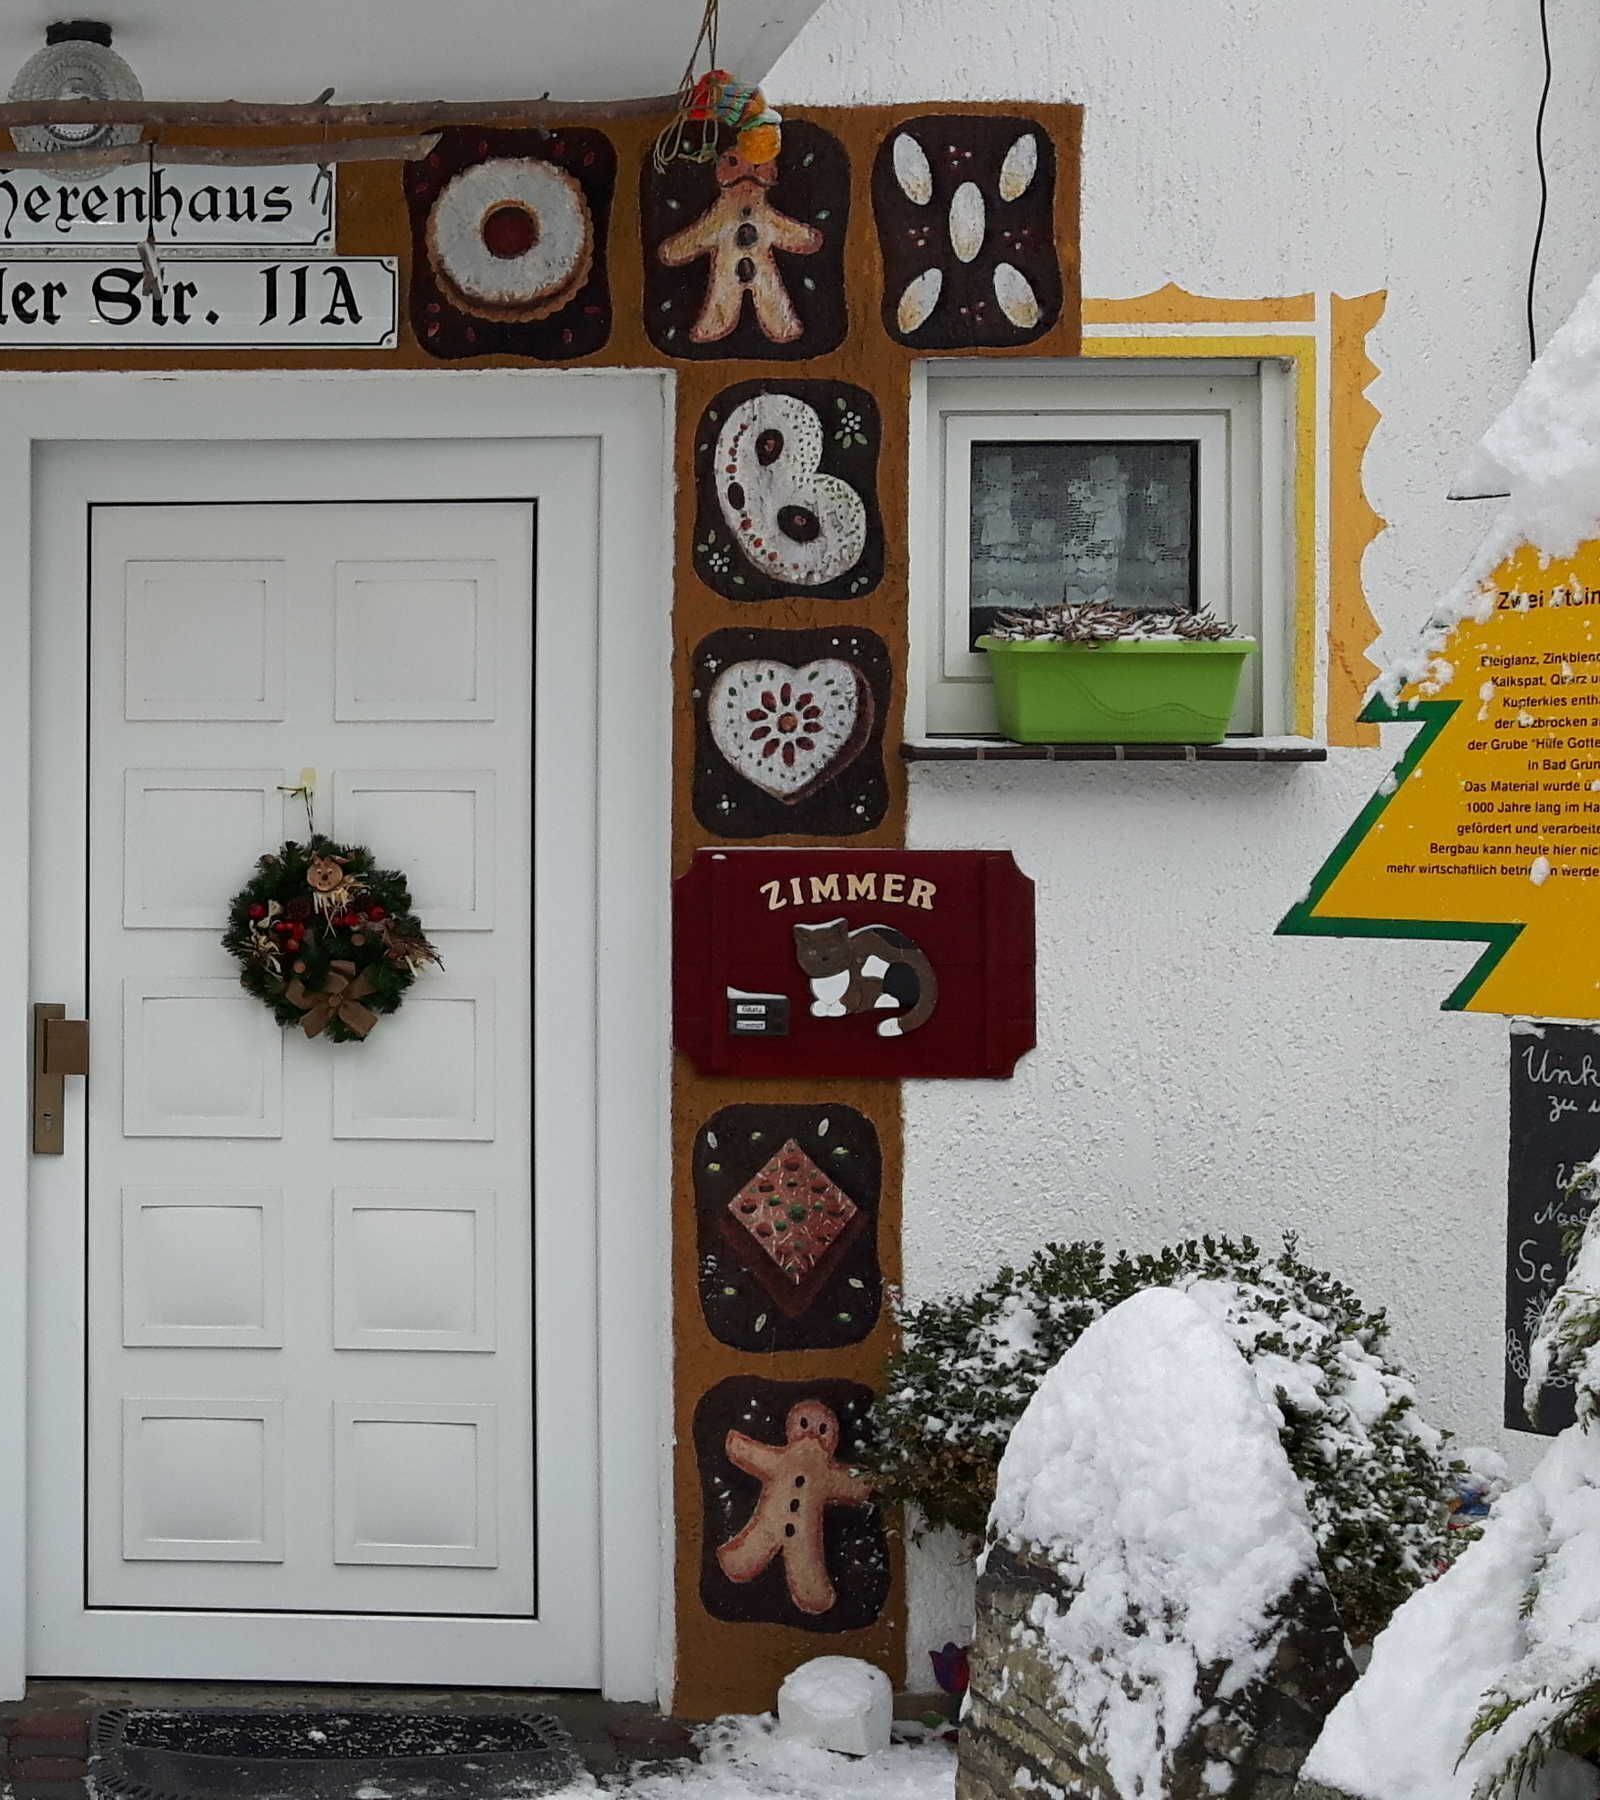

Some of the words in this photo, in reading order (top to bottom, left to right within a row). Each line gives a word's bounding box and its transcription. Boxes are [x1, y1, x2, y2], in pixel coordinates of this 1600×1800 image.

[92, 266, 220, 326] Str.
[1495, 717, 1514, 729] der
[1467, 739, 1488, 750] der
[1491, 738, 1528, 750] Grube
[1528, 759, 1539, 770] in
[1543, 758, 1566, 770] Bad
[1464, 780, 1487, 792] Das
[1491, 780, 1539, 792] Material
[1543, 780, 1580, 792] wurde
[1467, 801, 1494, 813] 1000
[1497, 801, 1532, 813] Jahre
[1535, 801, 1561, 816] lang
[1565, 802, 1579, 813] im
[1457, 822, 1512, 836] gefördert
[1515, 823, 1538, 834] und
[1430, 842, 1479, 857] Bergbau
[1483, 844, 1512, 855] kann
[1515, 844, 1550, 855] heute
[1553, 844, 1576, 855] hier
[1386, 863, 1415, 874] mehr
[1418, 863, 1497, 876] wirtschaftlich
[759, 871, 937, 911] ZIMMER
